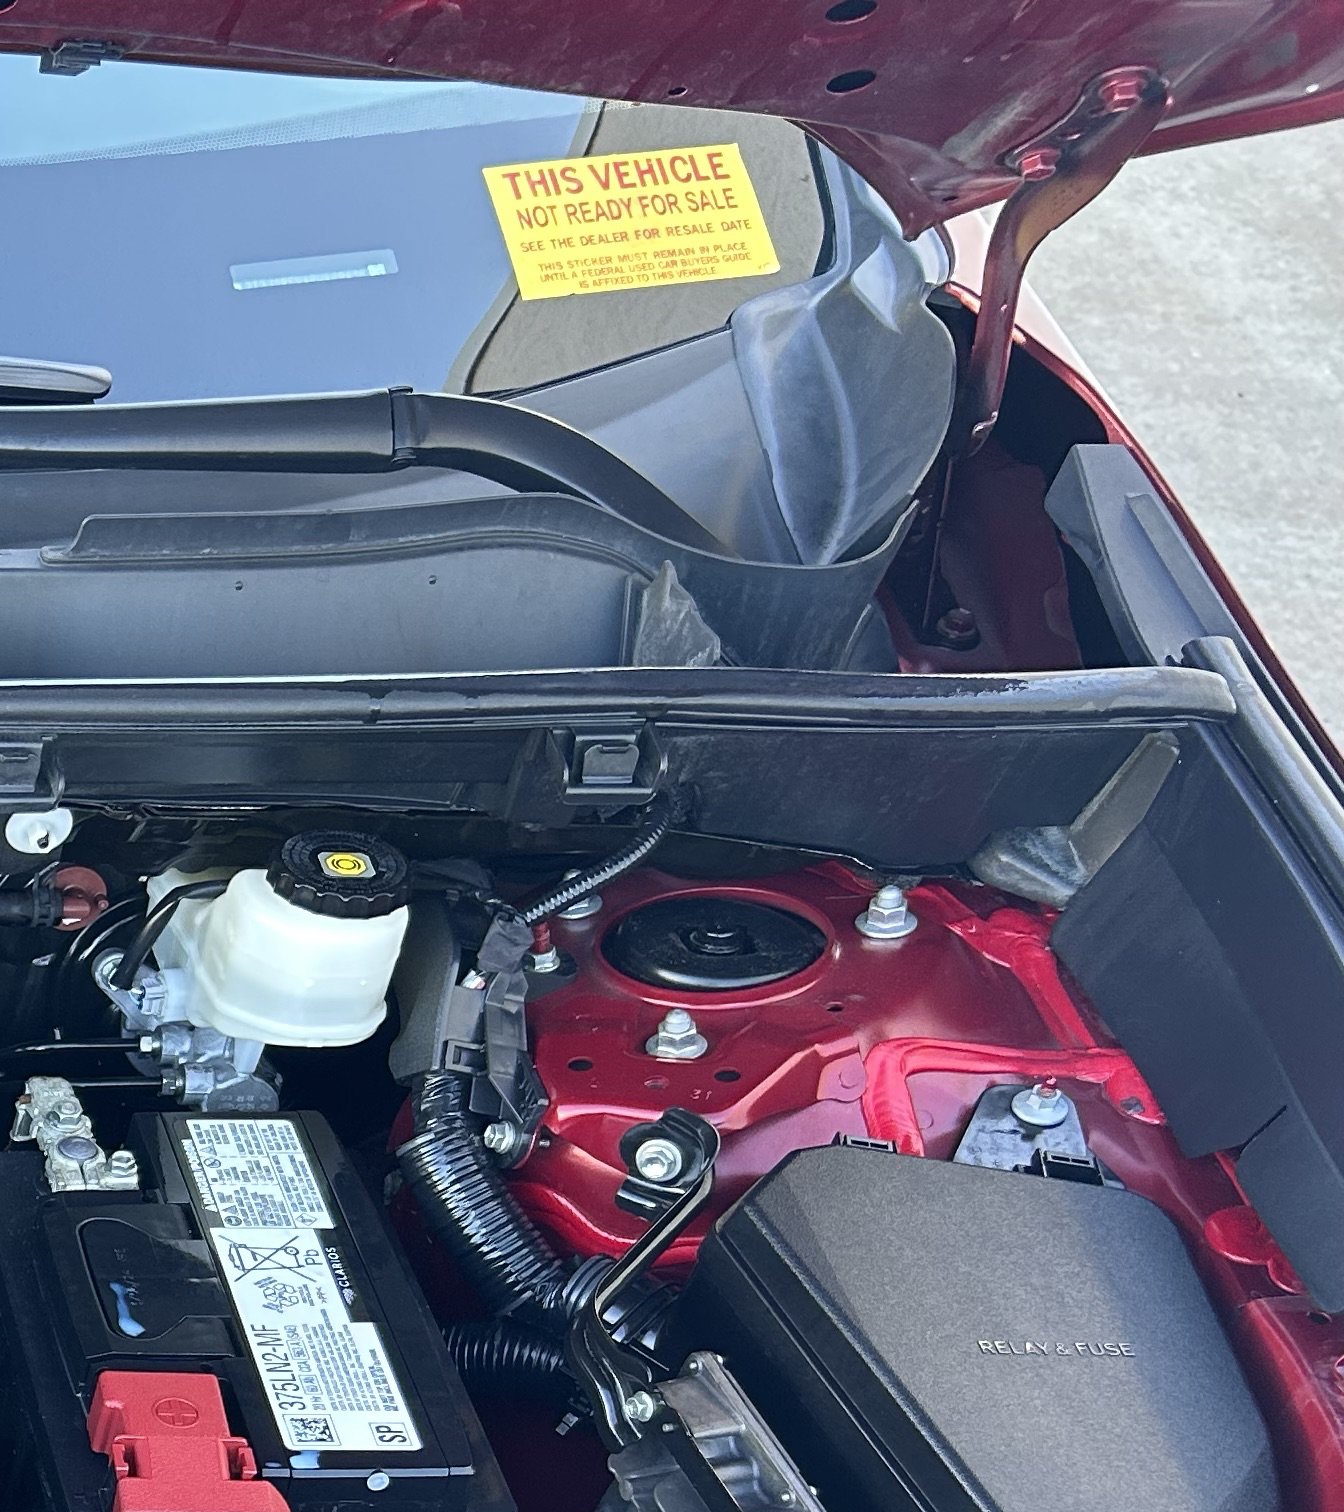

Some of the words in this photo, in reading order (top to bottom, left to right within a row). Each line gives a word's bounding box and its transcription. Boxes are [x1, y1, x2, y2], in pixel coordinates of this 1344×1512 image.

[502, 166, 584, 200] THIS
[587, 152, 730, 190] VEHICLE
[516, 204, 557, 230] NOT
[565, 197, 632, 225] READY
[638, 194, 682, 217] FOR
[685, 188, 738, 212] SALE
[520, 241, 545, 252] SEE
[550, 237, 574, 249] THE
[580, 231, 628, 246] DEALER
[635, 228, 661, 240] FOR
[666, 223, 714, 237] RESALE
[721, 219, 752, 231] DATE
[538, 261, 563, 272] THIS
[566, 256, 613, 268] STICKER
[617, 252, 647, 263] MUST
[653, 247, 695, 259] REMAIN
[713, 242, 747, 253] PLACE
[540, 273, 569, 282] UNTIL
[582, 266, 624, 278] FEDERAL
[628, 263, 655, 274] USED
[658, 260, 677, 269] CAR
[681, 255, 720, 268] BUYERS
[579, 280, 589, 288] IS
[592, 274, 634, 286] AFFIXED
[637, 273, 649, 282] TO
[652, 270, 674, 280] THIS
[678, 267, 717, 278] VEHICLE
[306, 1249, 323, 1266] Pb
[326, 1247, 350, 1287] CLARIOS
[977, 1340, 1049, 1355] RELAY
[1056, 1342, 1071, 1356] &
[1074, 1342, 1136, 1357] FUSE
[250, 1323, 306, 1411] 375LN2-MF
[375, 1425, 407, 1443] SP
